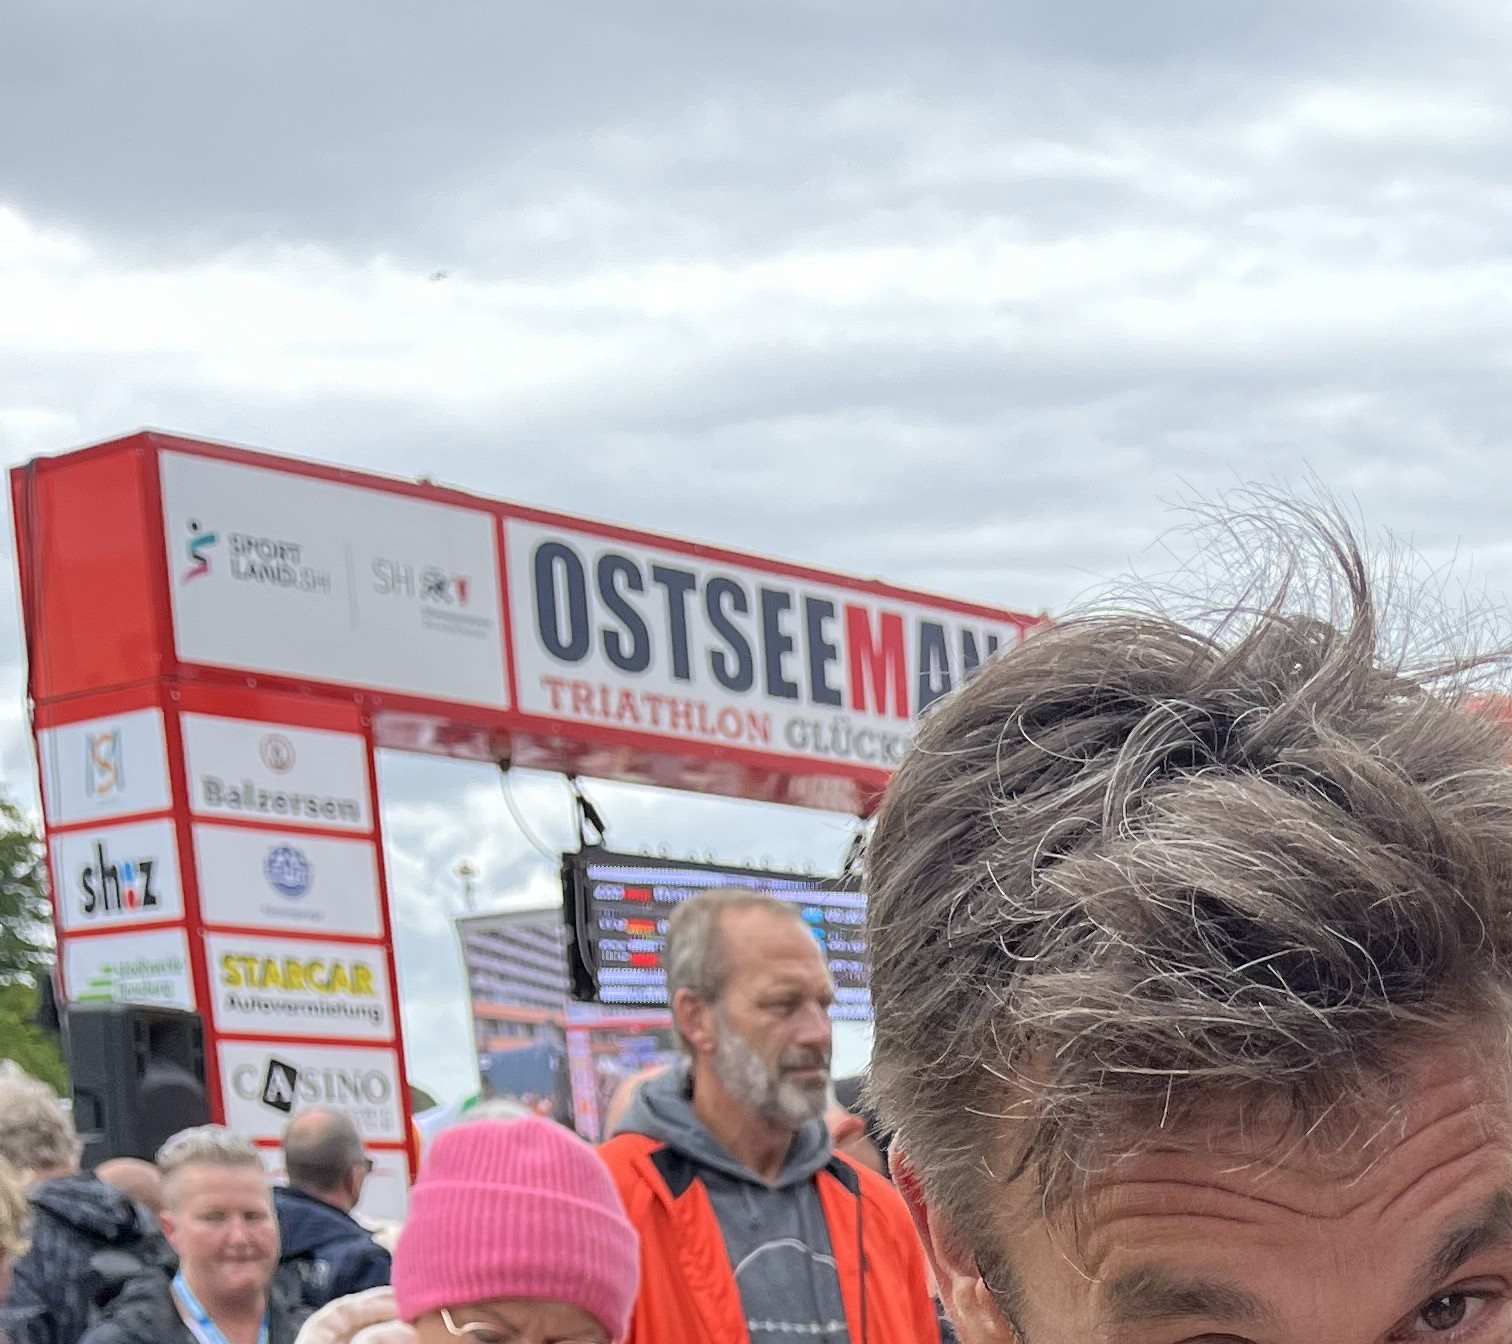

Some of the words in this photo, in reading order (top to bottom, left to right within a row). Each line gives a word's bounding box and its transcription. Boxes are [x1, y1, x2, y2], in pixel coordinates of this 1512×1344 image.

[542, 676, 772, 744] TRIATHLON
[784, 712, 904, 769] GLÜCK
[221, 954, 376, 996] STARCAR
[231, 1058, 391, 1113] CASINO
